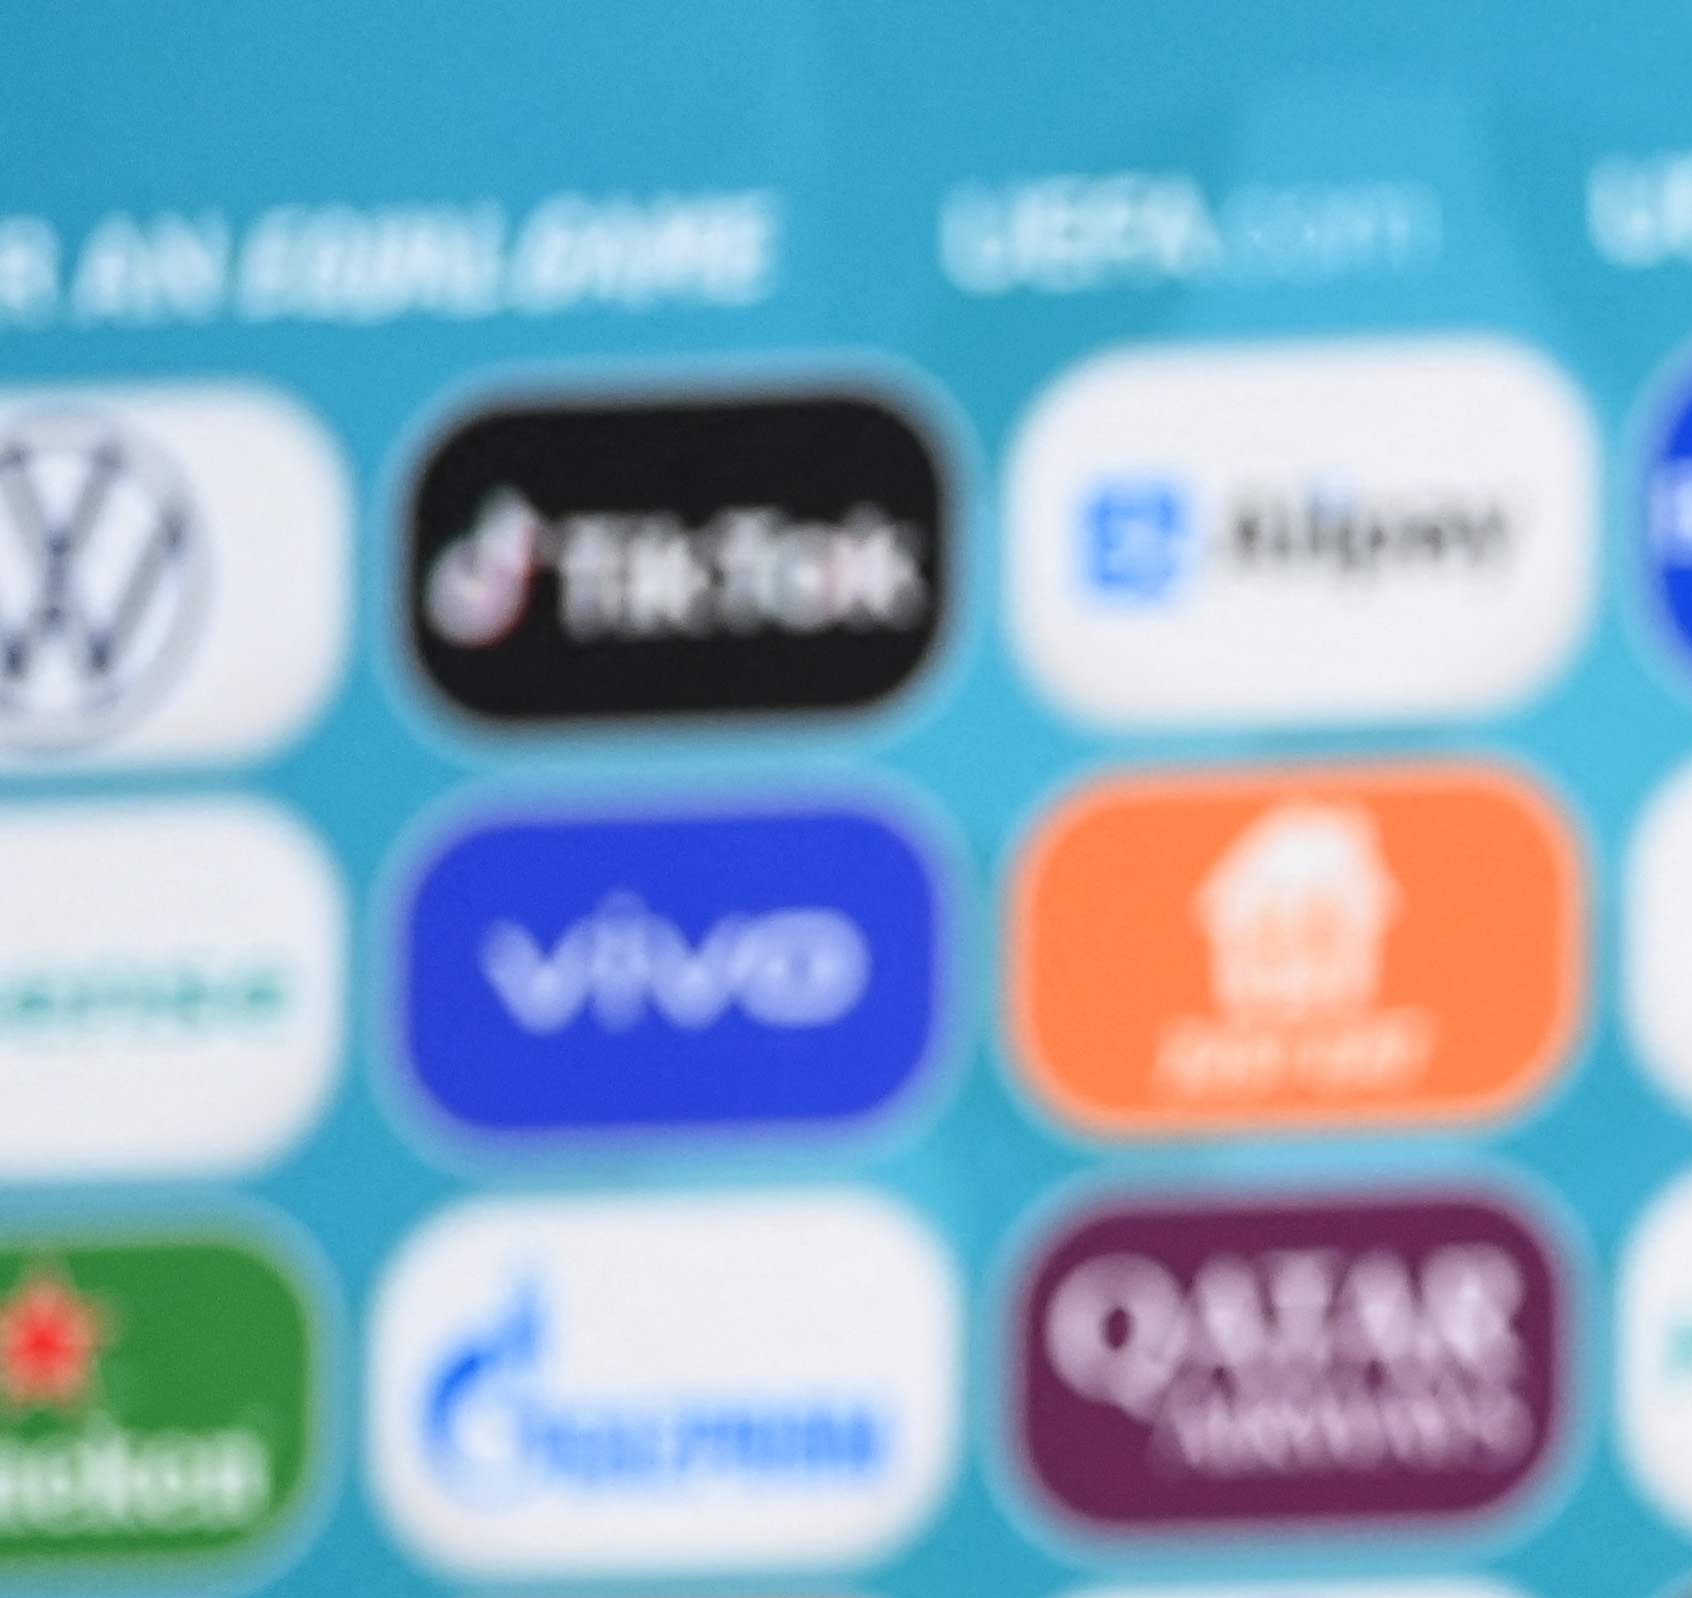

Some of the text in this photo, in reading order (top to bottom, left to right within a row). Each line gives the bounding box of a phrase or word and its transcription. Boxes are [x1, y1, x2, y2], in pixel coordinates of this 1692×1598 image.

[558, 502, 926, 642] TikTok
[480, 890, 872, 1036] vivo
[1045, 1245, 1528, 1415] QATAR
